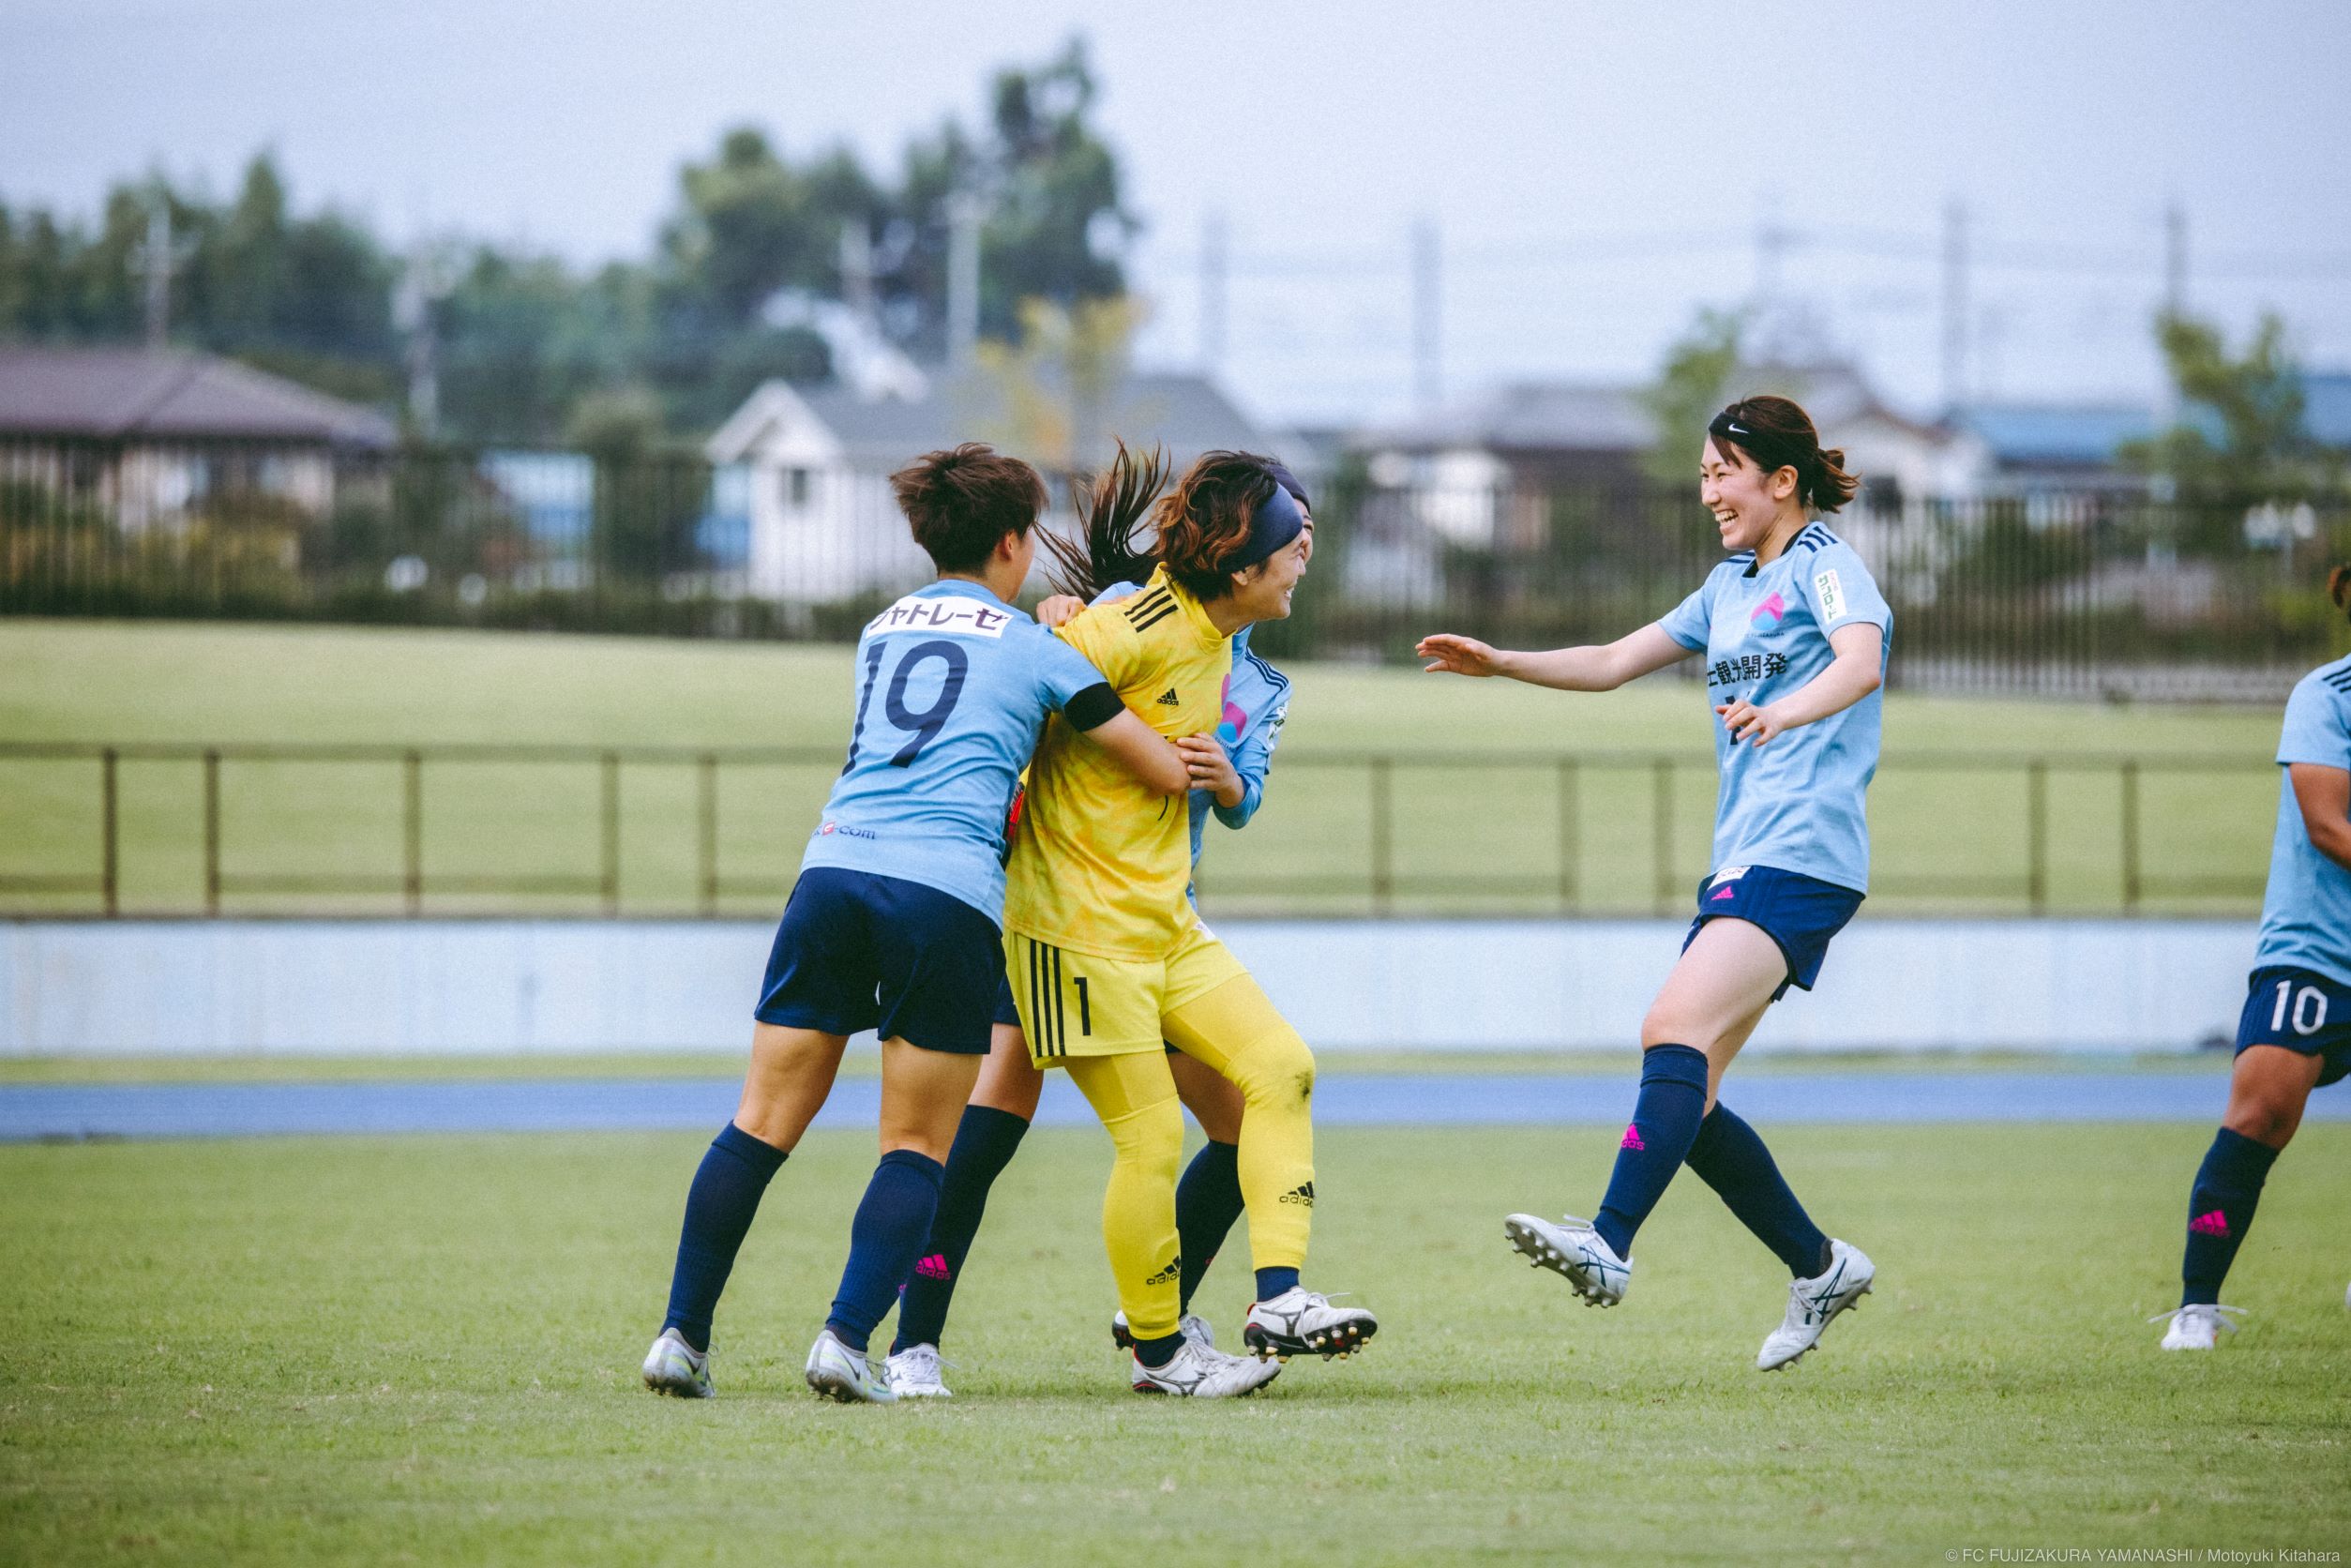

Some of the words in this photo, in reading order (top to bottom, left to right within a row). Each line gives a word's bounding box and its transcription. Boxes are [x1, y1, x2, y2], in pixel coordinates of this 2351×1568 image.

[1707, 652, 1787, 687] 士観光開発
[841, 640, 969, 777] 19
[1073, 976, 1092, 1036] 1
[2270, 980, 2328, 1036] 10
[1279, 1194, 1313, 1208] adid
[915, 1263, 951, 1281] adidas
